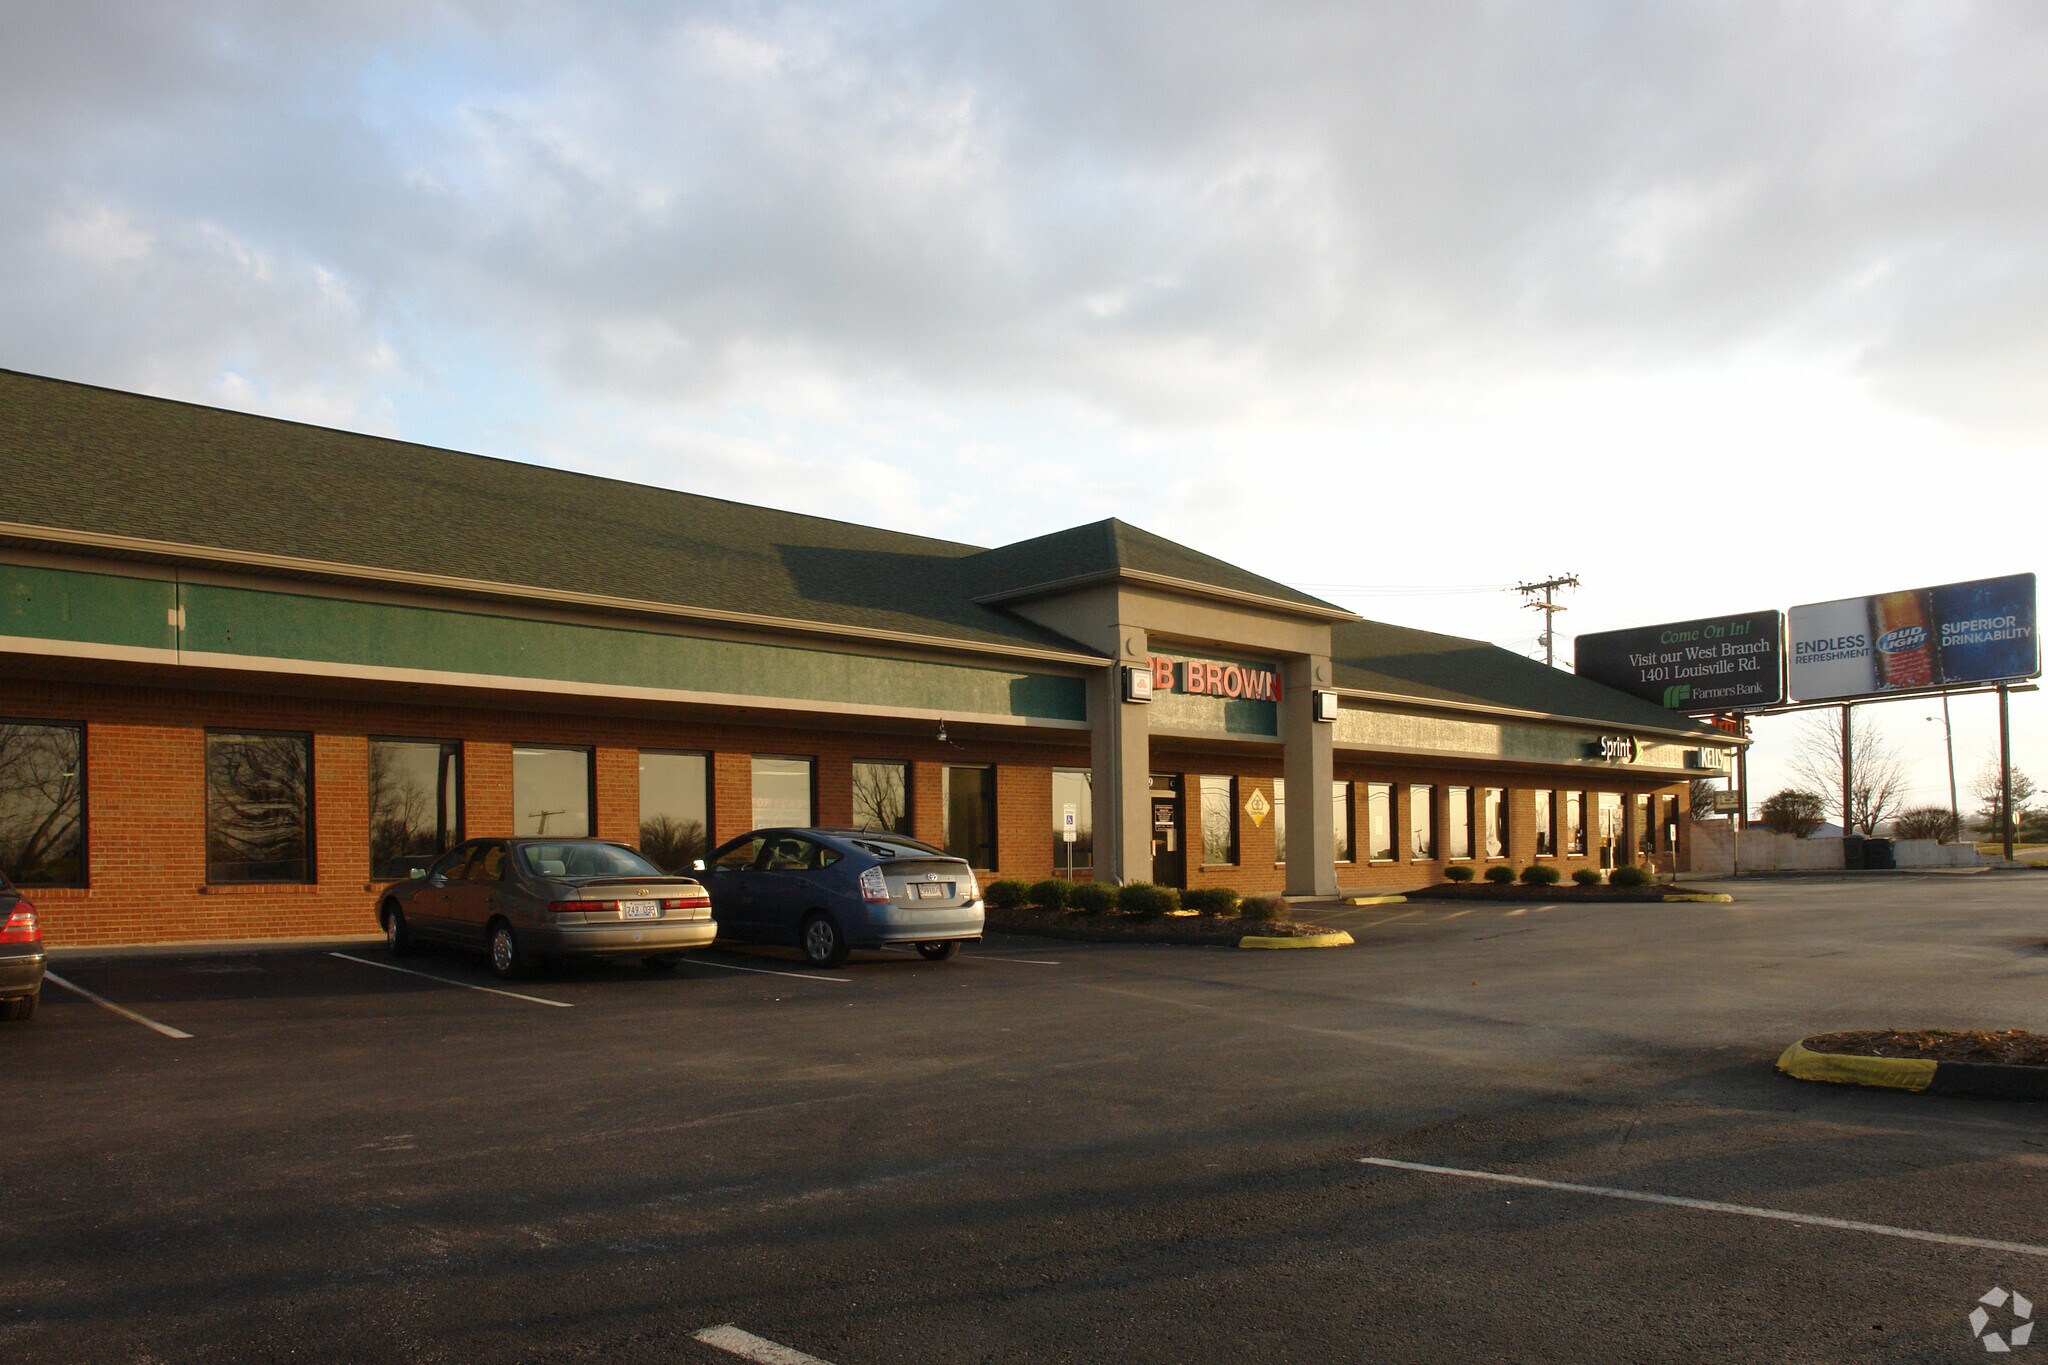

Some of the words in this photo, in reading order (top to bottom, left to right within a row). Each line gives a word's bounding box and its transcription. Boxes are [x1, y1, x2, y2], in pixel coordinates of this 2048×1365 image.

[1661, 630, 1700, 645] Come
[1703, 625, 1725, 639] On
[1730, 620, 1751, 636] In!
[1886, 626, 1923, 639] BUD
[1941, 615, 2017, 635] SUPERIOR
[1795, 634, 1866, 655] ENDLESS
[1882, 632, 1928, 650] LIGHT
[1942, 627, 2031, 647] DRINKABILITY
[1629, 651, 1658, 667] Visit
[1660, 651, 1683, 664] our
[1685, 645, 1718, 661] West
[1721, 638, 1770, 657] Branch
[1795, 648, 1871, 665] REFRESHMENT
[1640, 667, 1670, 682] 1401
[1674, 659, 1735, 679] Louisville
[1738, 656, 1760, 672] Rd.
[1187, 661, 1282, 702] BROWN
[1692, 685, 1736, 700] Farmers
[1736, 682, 1763, 696] Bank
[1601, 735, 1632, 761] Sprint
[1701, 747, 1725, 768] KELLY
